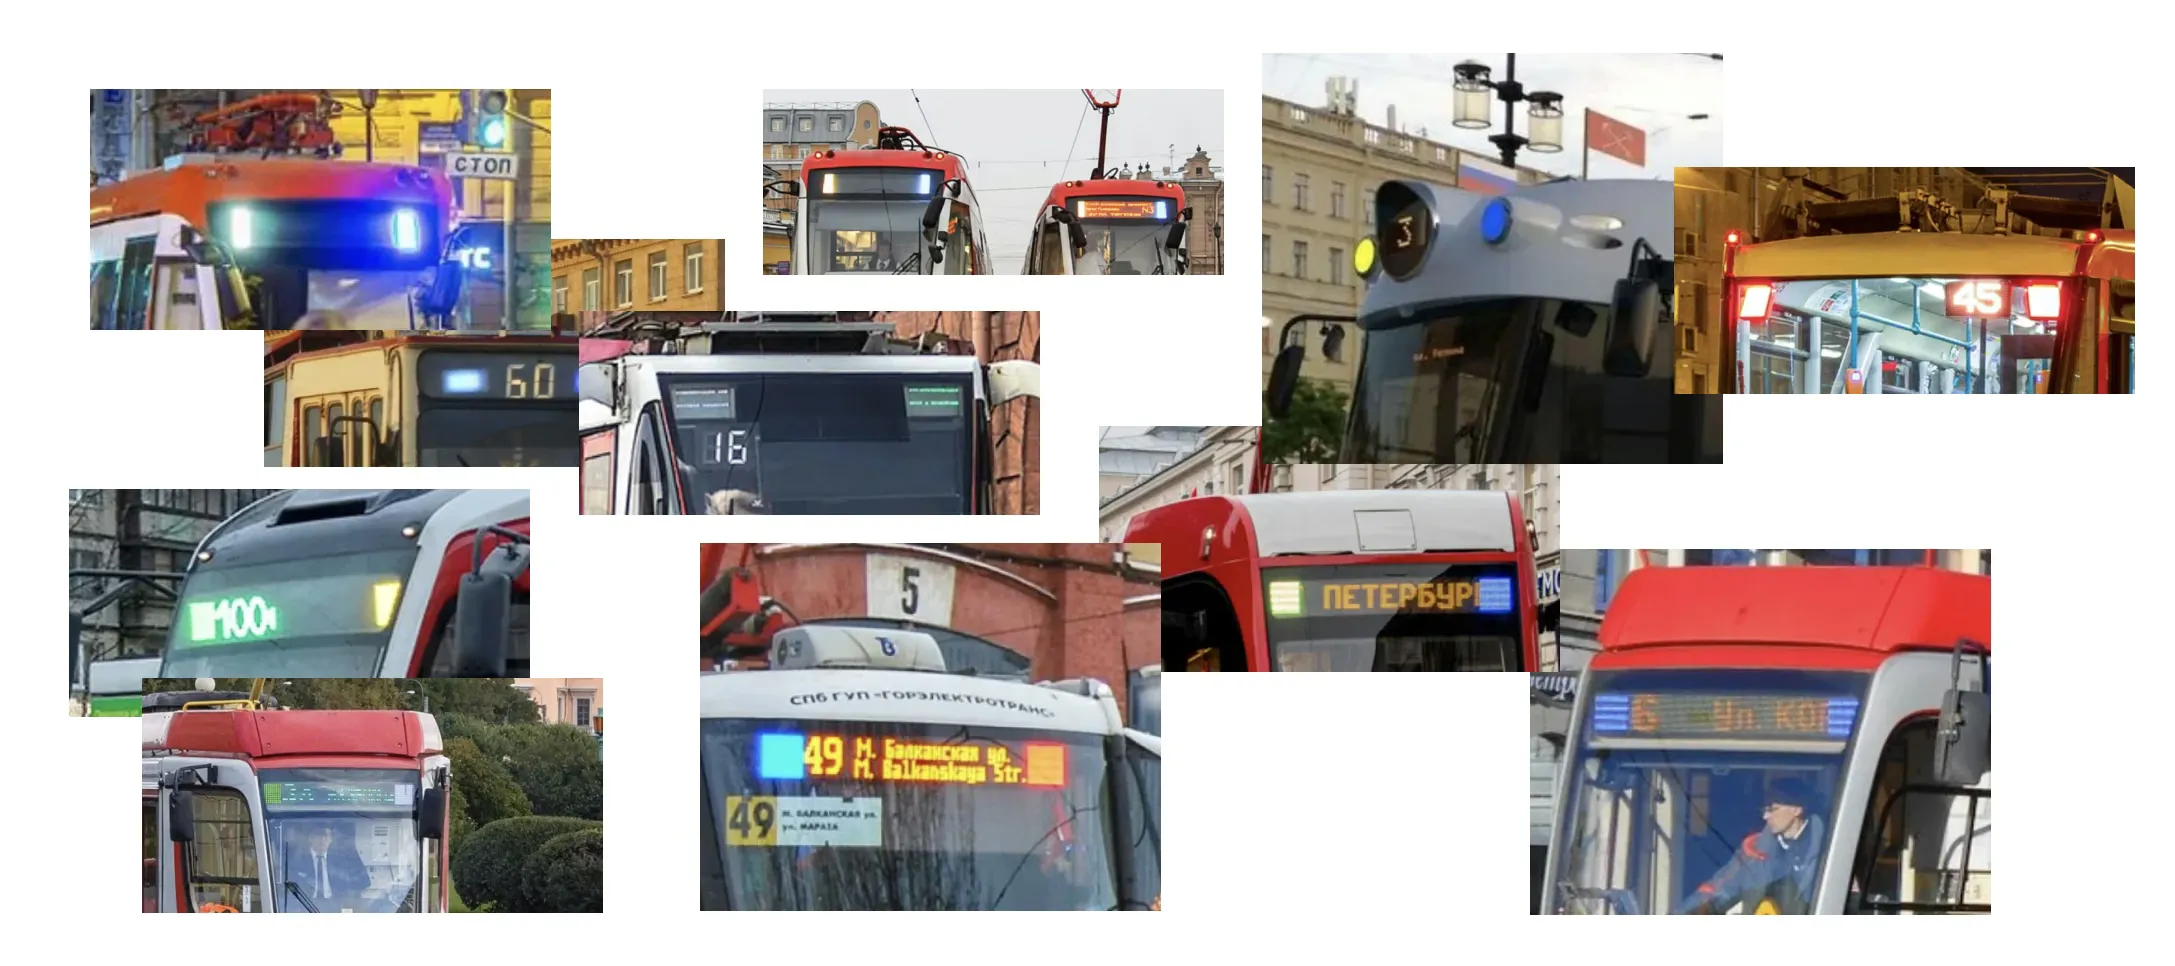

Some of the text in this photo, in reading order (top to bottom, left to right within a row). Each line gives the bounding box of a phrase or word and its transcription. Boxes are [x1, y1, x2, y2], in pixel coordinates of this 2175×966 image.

[455, 157, 511, 173] СТОП
[1397, 216, 1413, 247] 3
[1952, 282, 2002, 314] 45
[505, 363, 554, 399] 60
[715, 430, 747, 464] 16
[901, 566, 919, 614] 5
[832, 690, 870, 701] ГУП
[1631, 693, 1661, 733] 6
[803, 736, 844, 775] 49
[856, 738, 1011, 765] М. Балканская ул.
[882, 759, 986, 784] Balkanskaya
[993, 763, 1028, 783] Str.
[729, 801, 774, 839] 49
[796, 810, 860, 818] БАЛКАНСКАЯ
